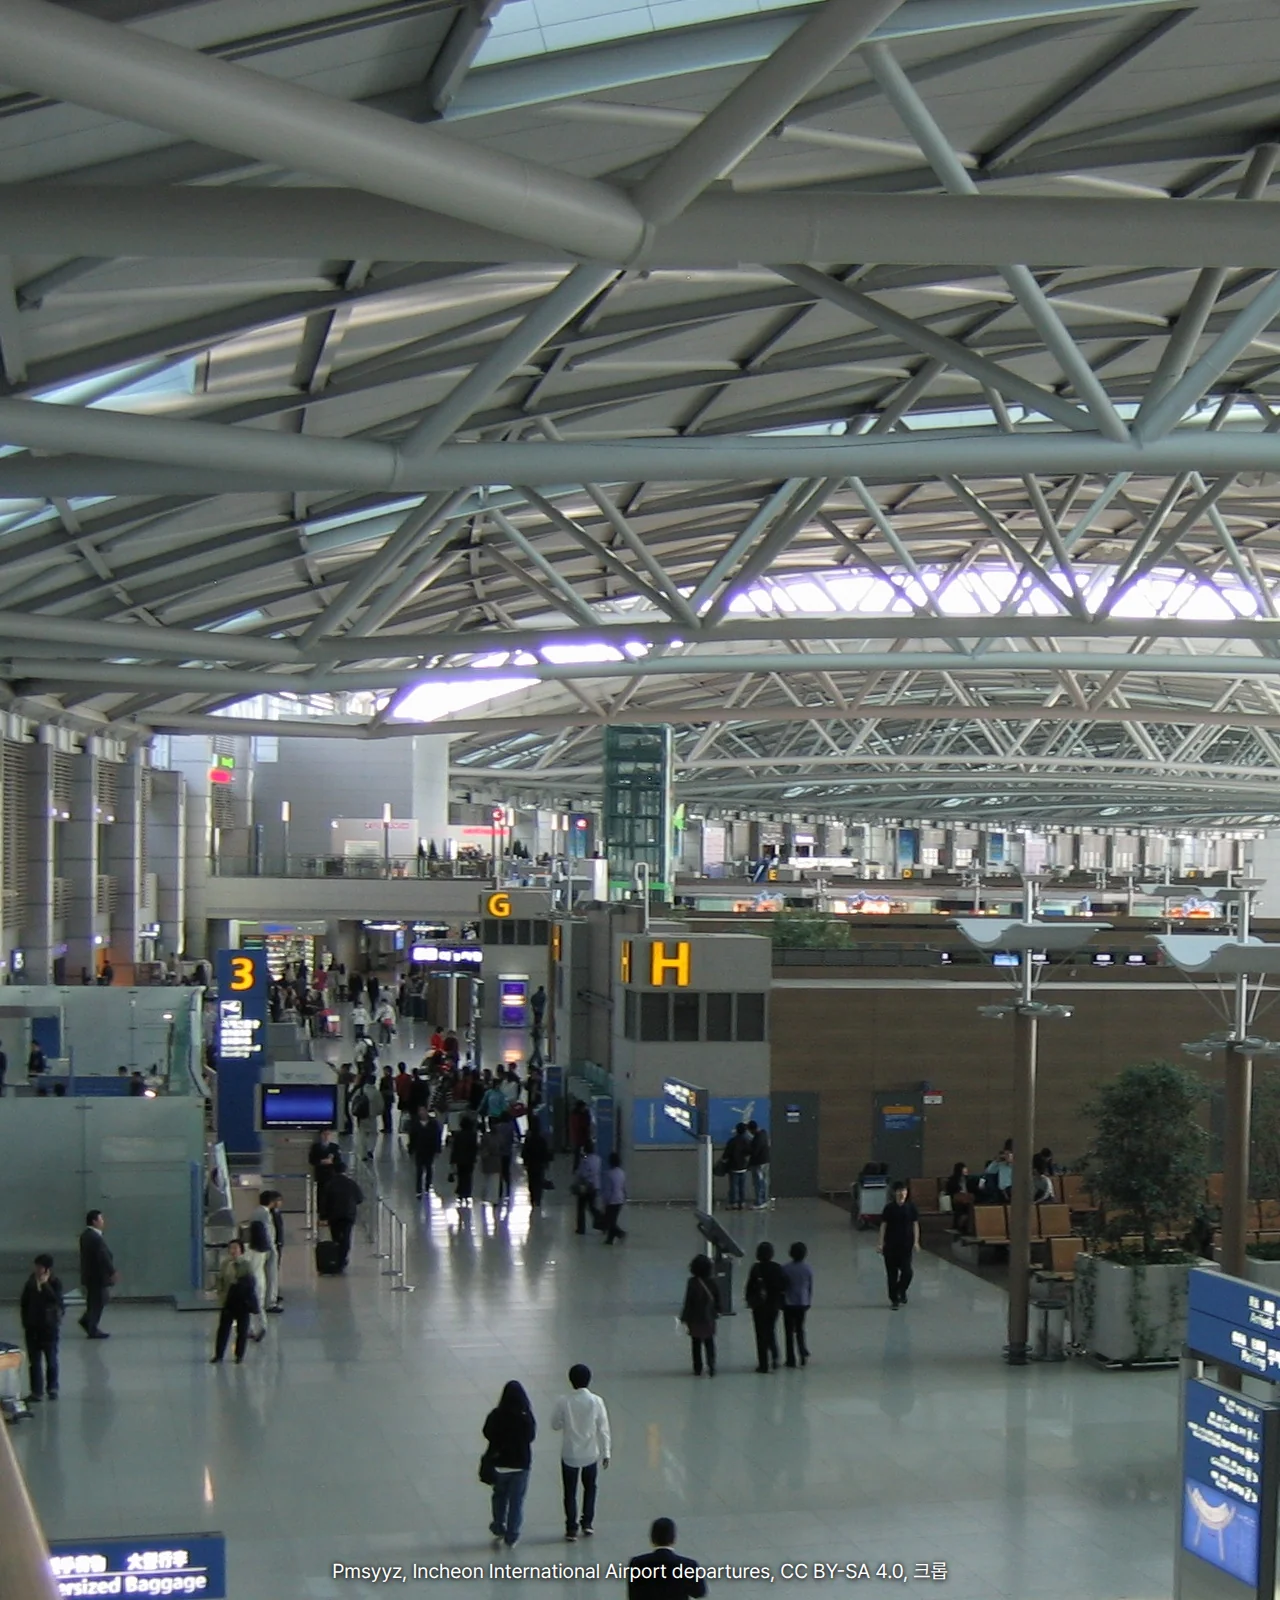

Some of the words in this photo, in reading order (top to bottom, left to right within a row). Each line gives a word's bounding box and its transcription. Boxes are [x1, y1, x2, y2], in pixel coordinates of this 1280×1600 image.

[488, 892, 512, 917] G
[230, 957, 255, 991] 3
[650, 940, 692, 987] H
[124, 1575, 207, 1596] Baggage
